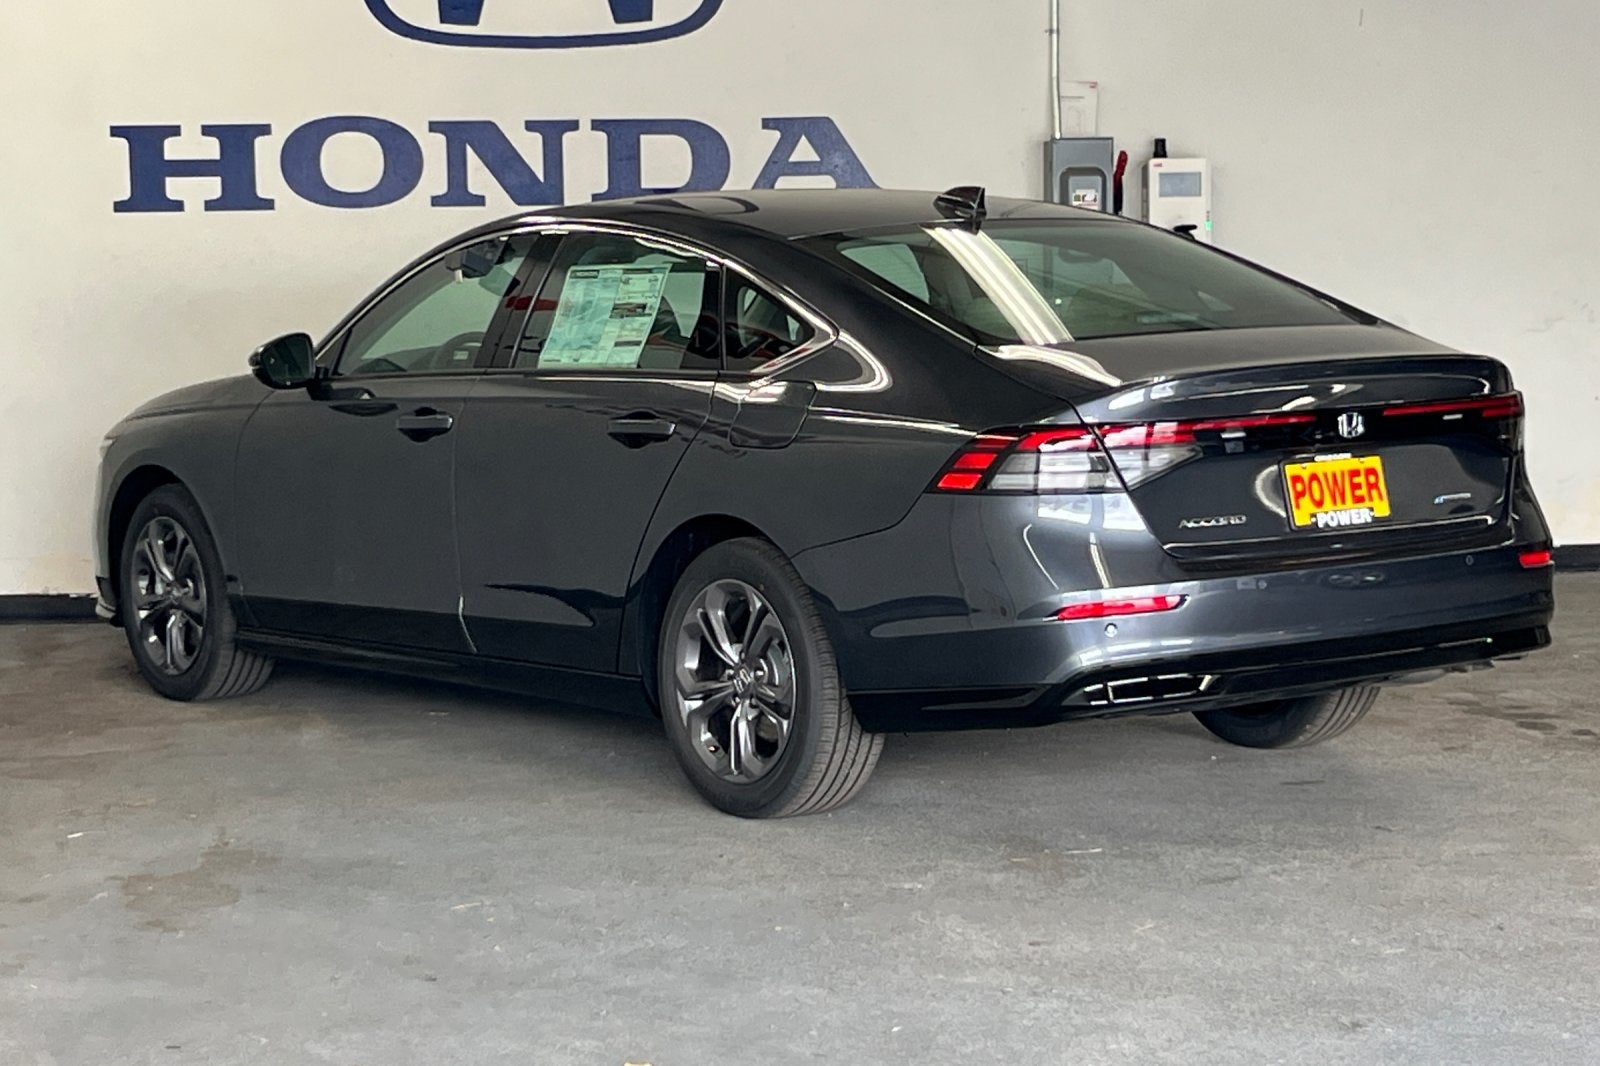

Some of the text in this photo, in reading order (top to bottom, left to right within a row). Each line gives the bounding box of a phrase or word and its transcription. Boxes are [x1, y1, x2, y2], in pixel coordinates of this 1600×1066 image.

[111, 115, 878, 213] HONDA
[1290, 467, 1384, 510] POWER
[1179, 515, 1247, 528] ACCORD
[1316, 508, 1372, 528] POWER
